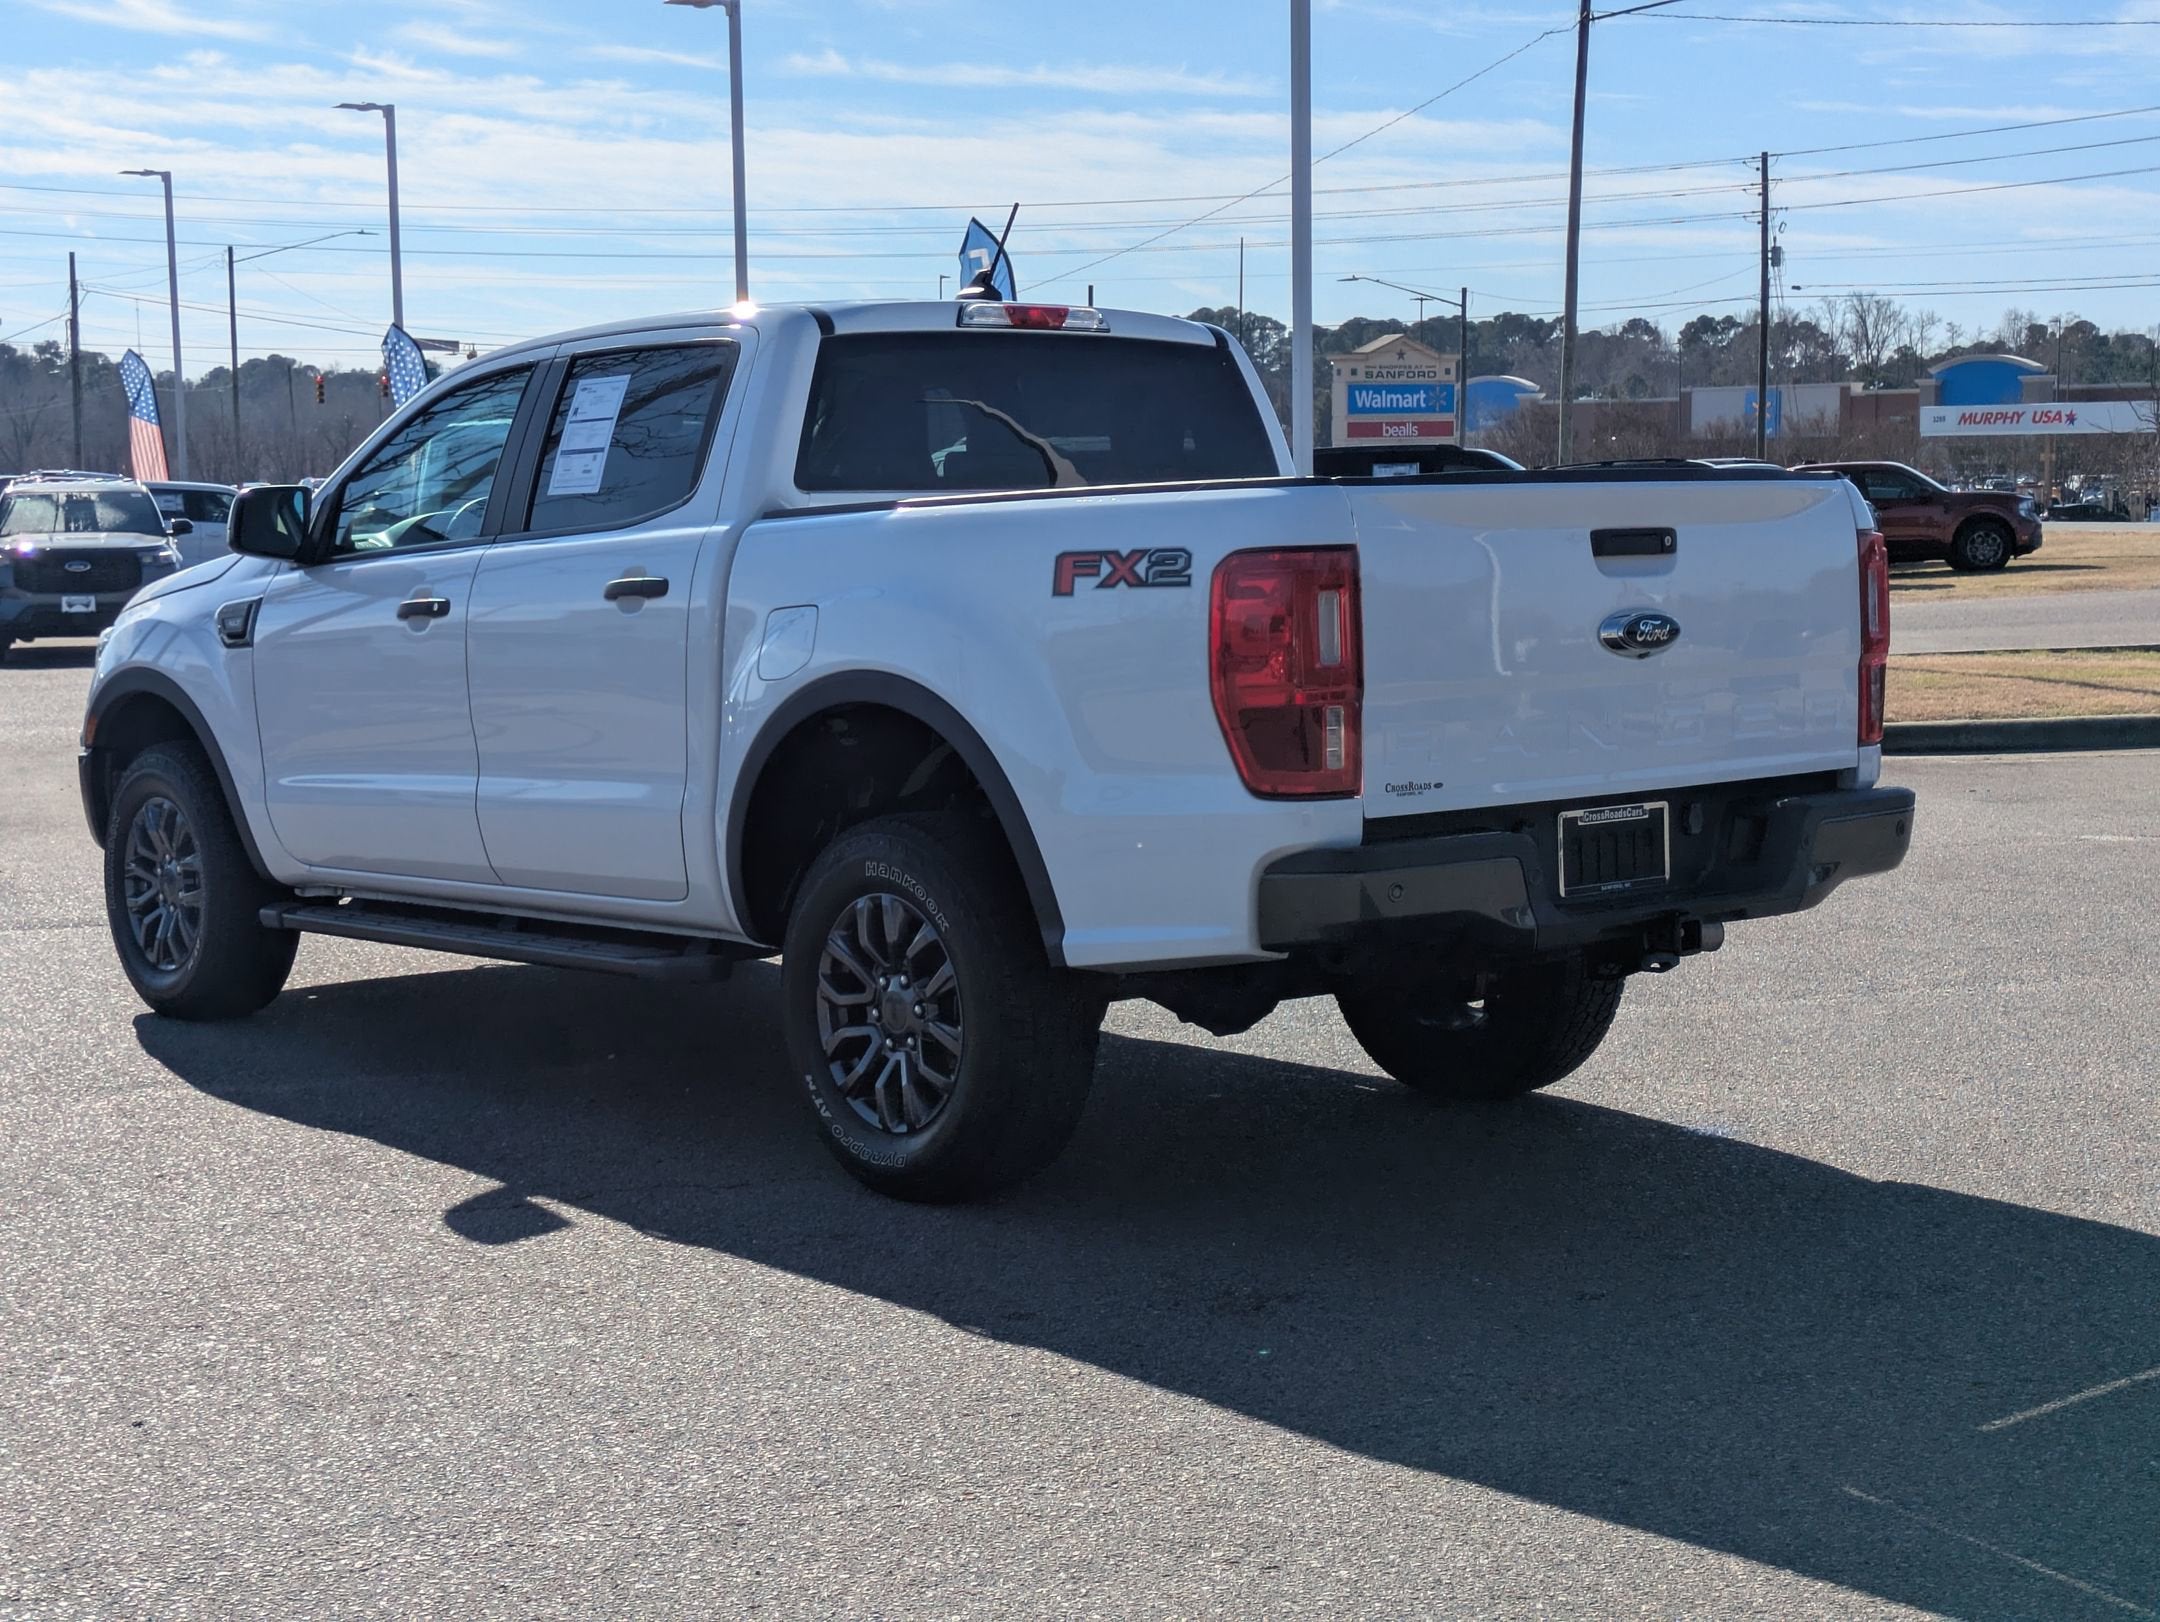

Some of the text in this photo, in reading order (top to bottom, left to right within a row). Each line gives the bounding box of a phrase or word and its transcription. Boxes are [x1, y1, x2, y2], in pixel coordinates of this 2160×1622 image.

[1364, 370, 1437, 379] SANFORD
[1355, 389, 1426, 409] Walmart
[1957, 409, 2063, 426] MURPHY USA
[1382, 422, 1418, 437] bealls
[1052, 547, 1192, 597] FX2
